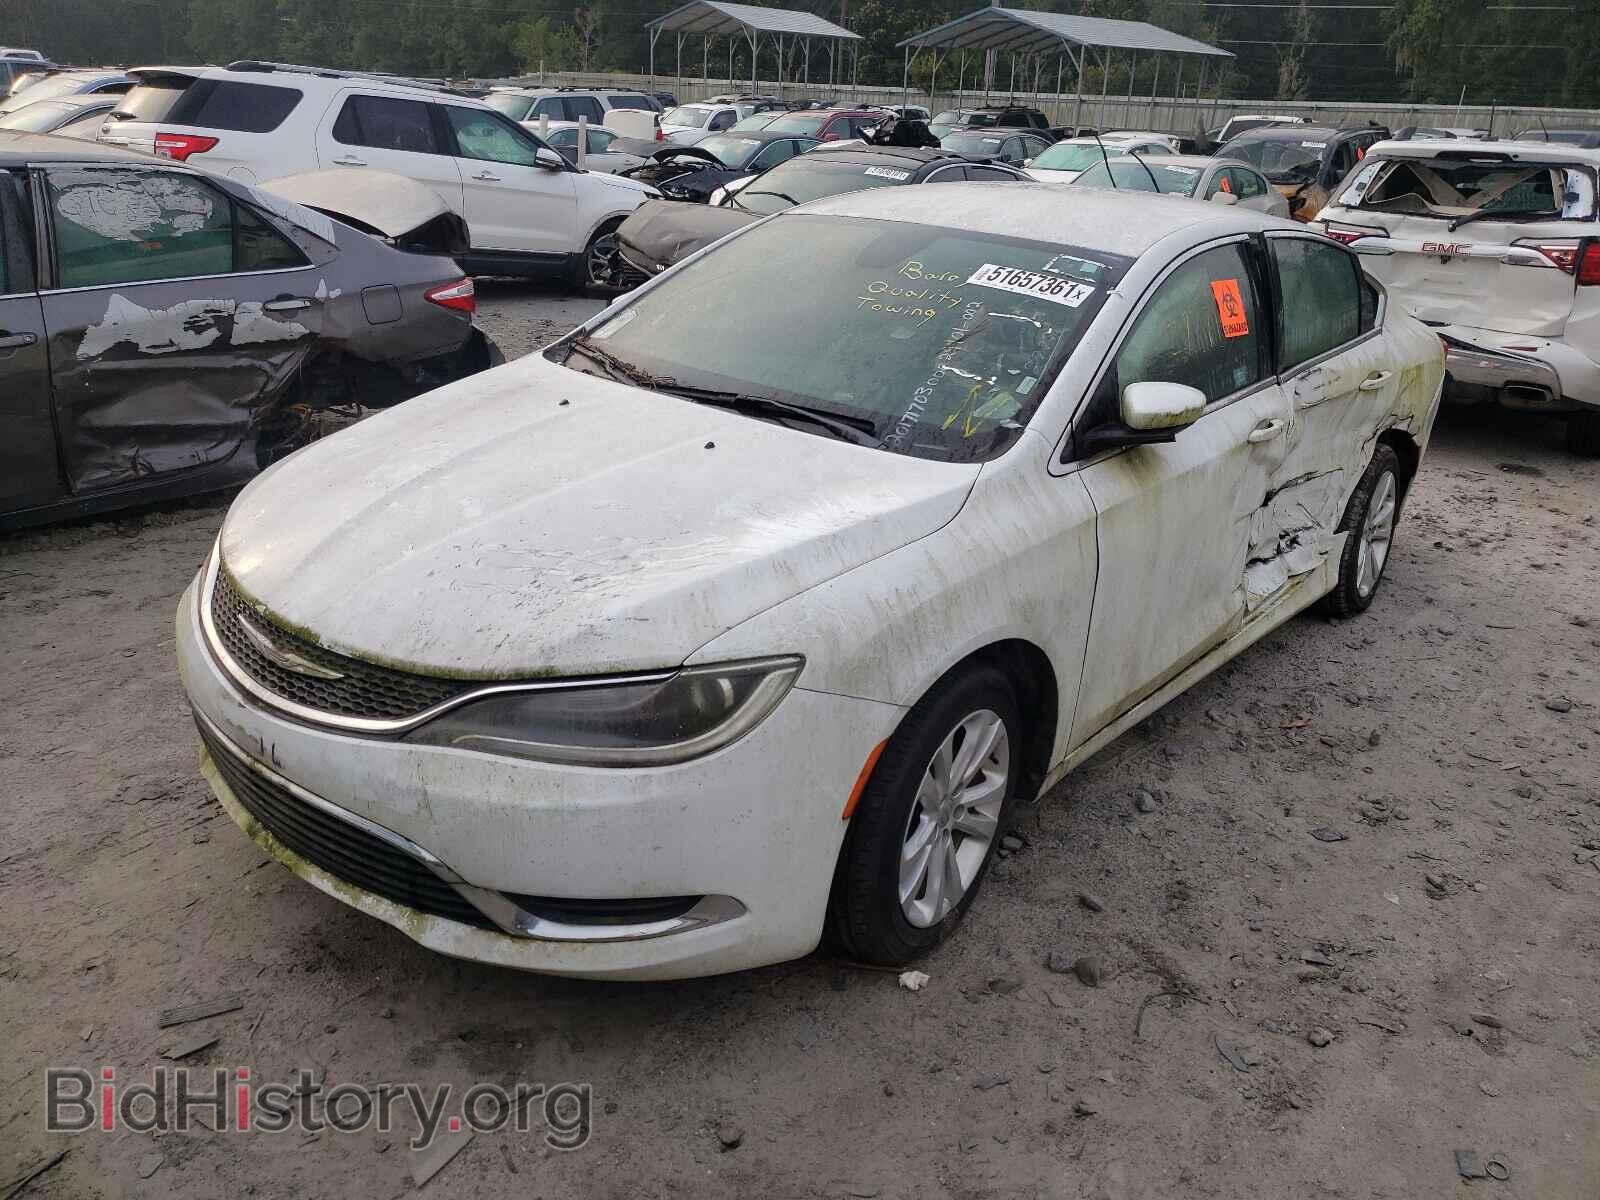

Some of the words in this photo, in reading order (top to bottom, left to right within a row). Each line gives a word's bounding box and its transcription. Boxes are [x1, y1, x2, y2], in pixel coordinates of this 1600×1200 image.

[1422, 242, 1471, 256] GMC
[868, 281, 963, 309] Quality
[857, 296, 936, 327] Towing
